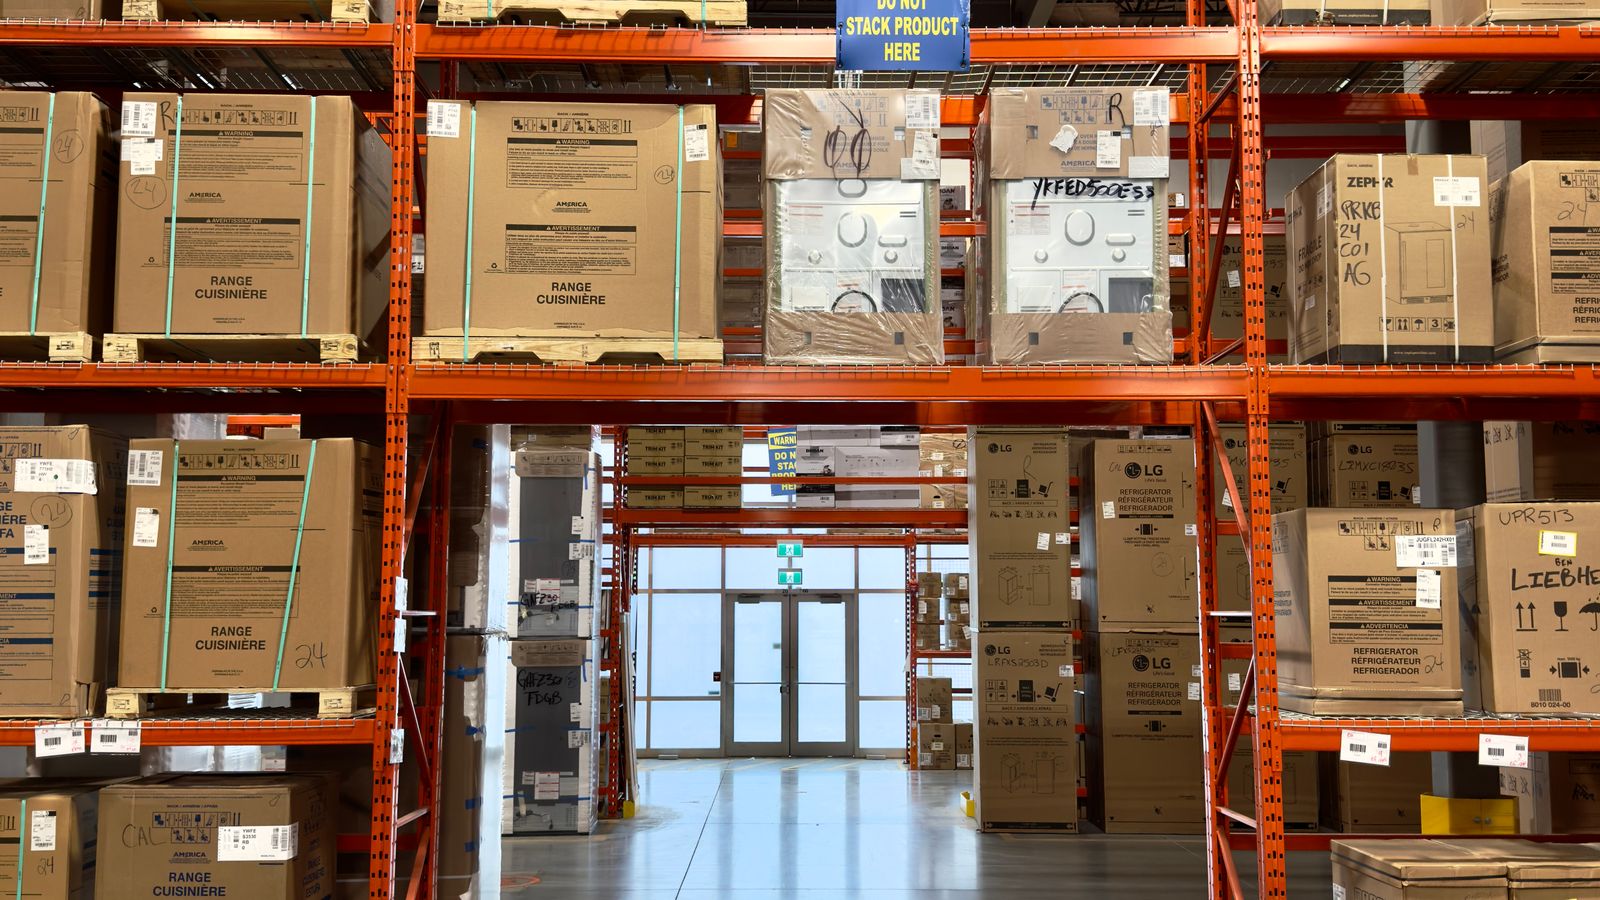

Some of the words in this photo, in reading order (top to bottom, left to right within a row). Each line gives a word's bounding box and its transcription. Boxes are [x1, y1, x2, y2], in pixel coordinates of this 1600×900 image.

[846, 16, 891, 36] STACK
[894, 16, 959, 36] PRODUCT
[884, 42, 920, 61] HERE
[160, 101, 175, 131] R
[1109, 93, 1126, 127] R
[57, 138, 73, 158] 24
[131, 179, 156, 203] 24
[1558, 201, 1588, 225] 24
[1340, 224, 1360, 241] 24
[1344, 261, 1371, 286] AG
[210, 276, 252, 286] RANGE
[551, 282, 591, 292] RANGE
[195, 287, 267, 299] CUISINIÈRE
[536, 293, 606, 305] CUISINIÈRE
[1431, 319, 1439, 328] 3
[775, 452, 787, 460] DO
[1145, 465, 1163, 476] LG
[1499, 507, 1574, 526] UPR513
[1555, 557, 1572, 566] BEN
[1511, 566, 1600, 591] LIEBHE
[211, 626, 252, 636] RANGE
[195, 638, 266, 650] CUISINIÈRE
[998, 646, 1010, 654] LG
[295, 641, 328, 669] 24
[1351, 656, 1421, 665] RÉFRIGÉRATEUR
[1153, 658, 1171, 669] LG
[122, 824, 167, 848] CAL
[168, 872, 212, 883] RANGE
[153, 884, 226, 897] CUISINIÈRE
